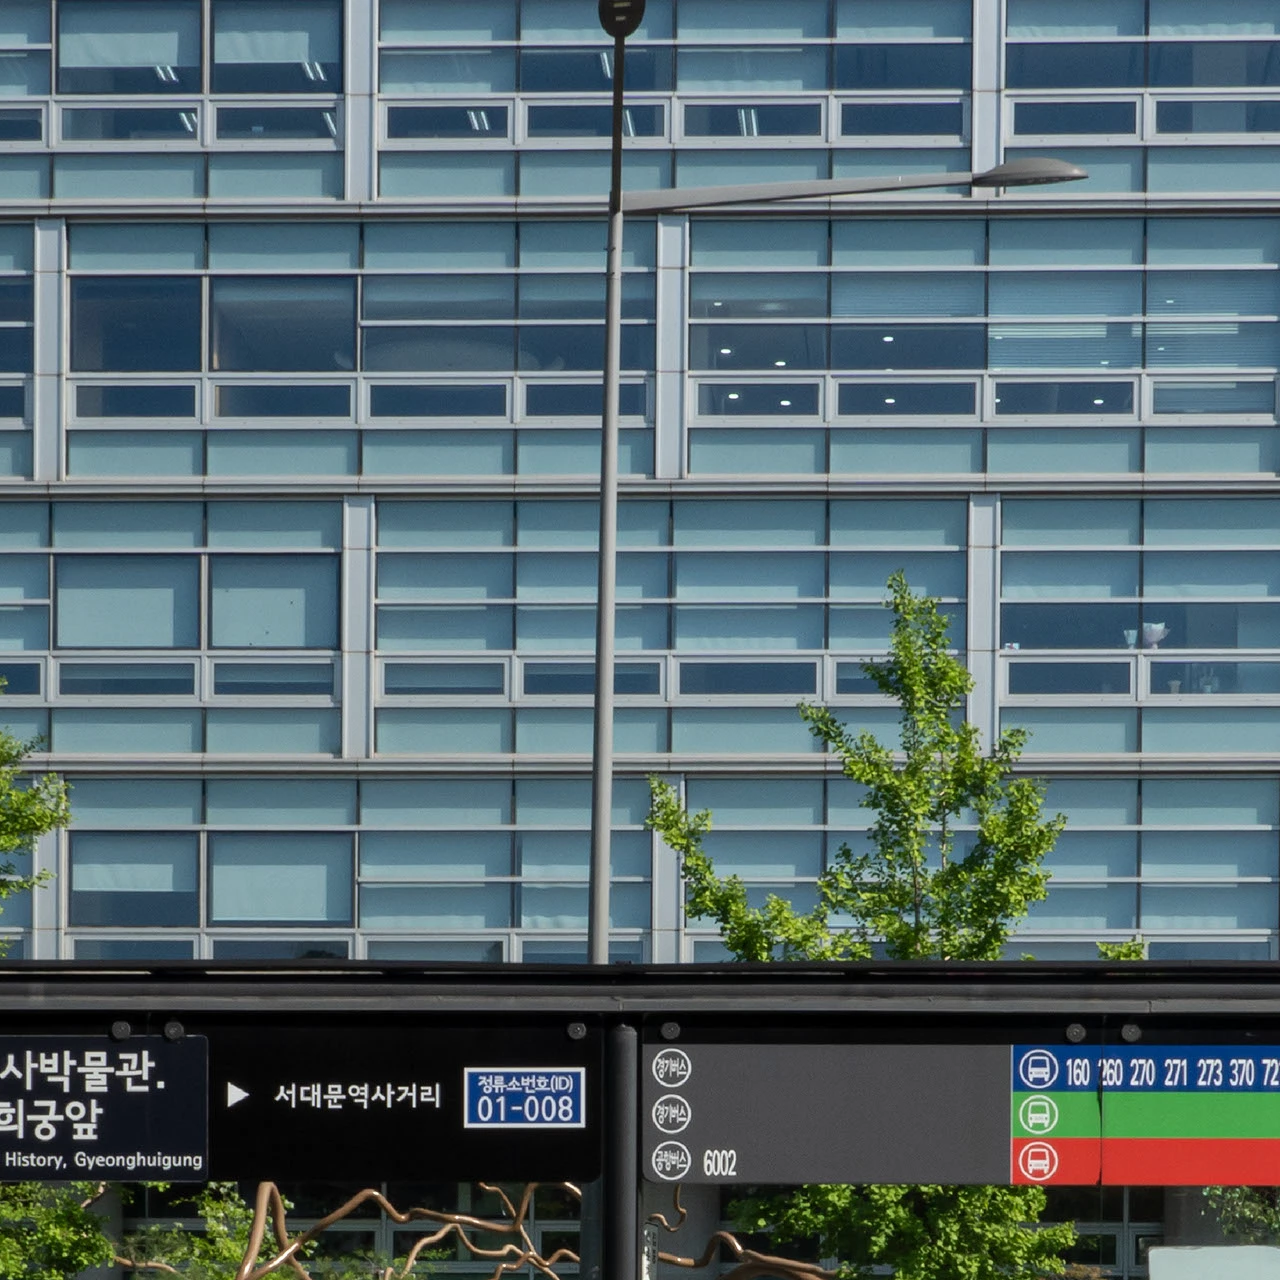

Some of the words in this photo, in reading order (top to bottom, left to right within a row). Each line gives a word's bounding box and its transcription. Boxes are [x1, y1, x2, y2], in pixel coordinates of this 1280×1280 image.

[656, 1057, 687, 1079] 경기버스
[1066, 1058, 1091, 1086] 160
[1097, 1058, 1124, 1086] 260
[1129, 1058, 1156, 1086] 270
[1164, 1058, 1187, 1086] 271
[1197, 1058, 1223, 1086] 273
[1229, 1058, 1255, 1086] 370
[477, 1074, 574, 1093] 정류소번호(ID)
[274, 1082, 440, 1110] 서대문역사거리
[477, 1096, 574, 1122] 01-008
[656, 1103, 687, 1125] 경기버스
[5, 1151, 67, 1170] History,
[74, 1151, 203, 1172] Gyeonghuigung
[656, 1150, 687, 1172] 공항버스
[703, 1149, 737, 1176] 6002
